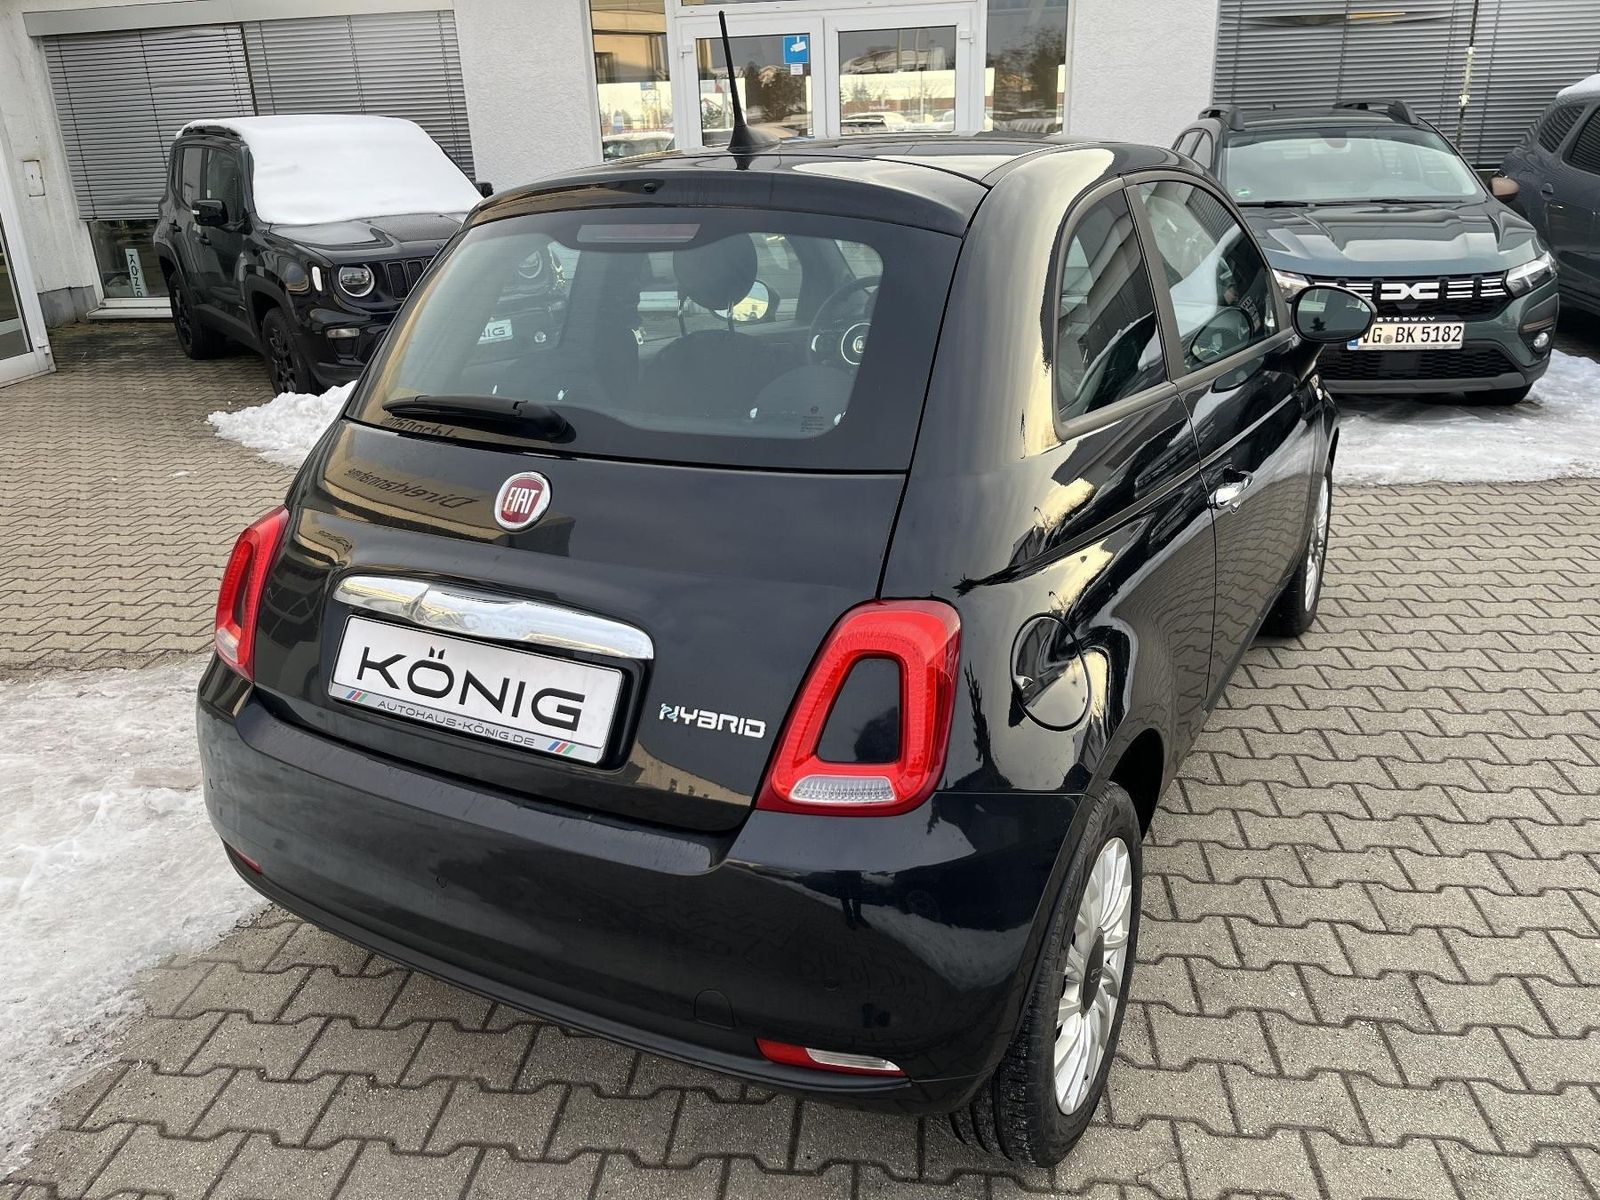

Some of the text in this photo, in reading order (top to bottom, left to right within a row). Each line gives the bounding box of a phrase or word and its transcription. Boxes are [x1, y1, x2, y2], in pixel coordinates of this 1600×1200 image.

[1395, 326, 1417, 343] BK
[1421, 326, 1462, 343] 5182
[503, 487, 540, 514] FIAT
[356, 646, 586, 732] KÖNIG
[658, 703, 767, 739] HYBRID
